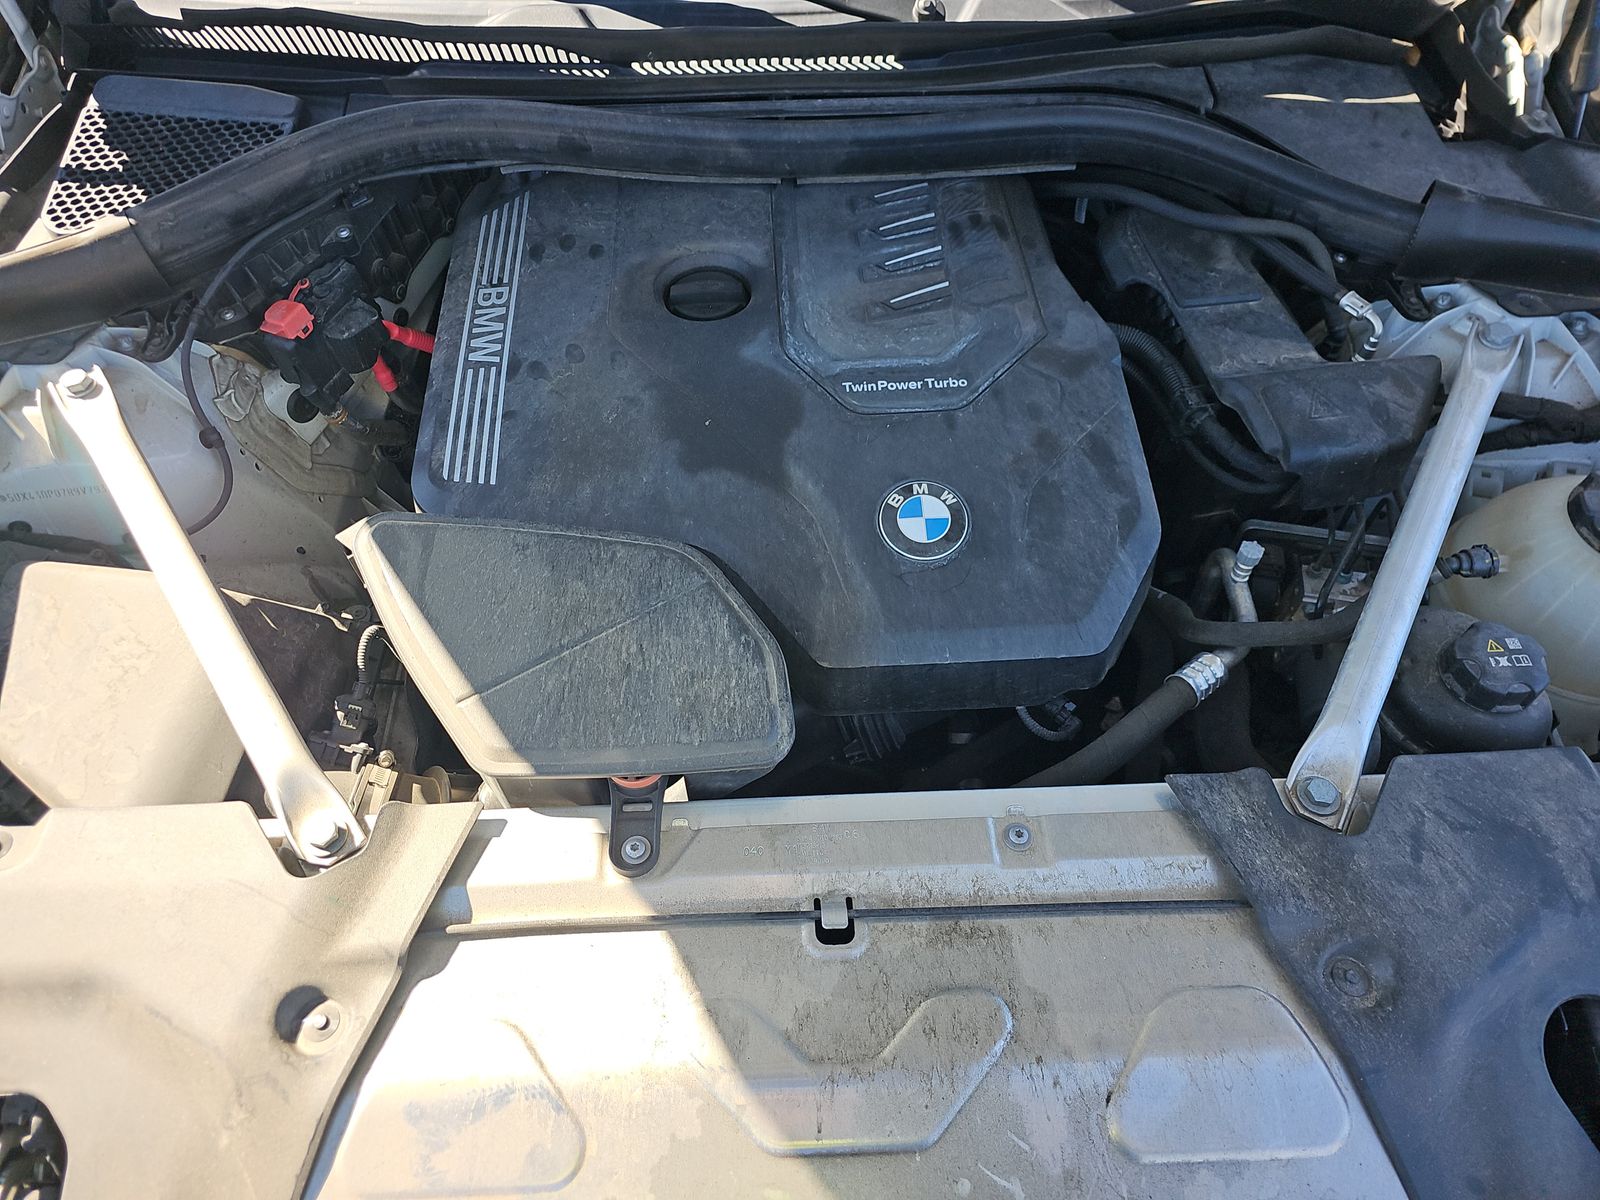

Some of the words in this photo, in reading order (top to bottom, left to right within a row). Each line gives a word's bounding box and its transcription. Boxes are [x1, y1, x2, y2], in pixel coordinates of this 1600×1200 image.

[467, 286, 509, 363] BMW
[924, 376, 968, 389] Turbo
[887, 483, 957, 509] BMW
